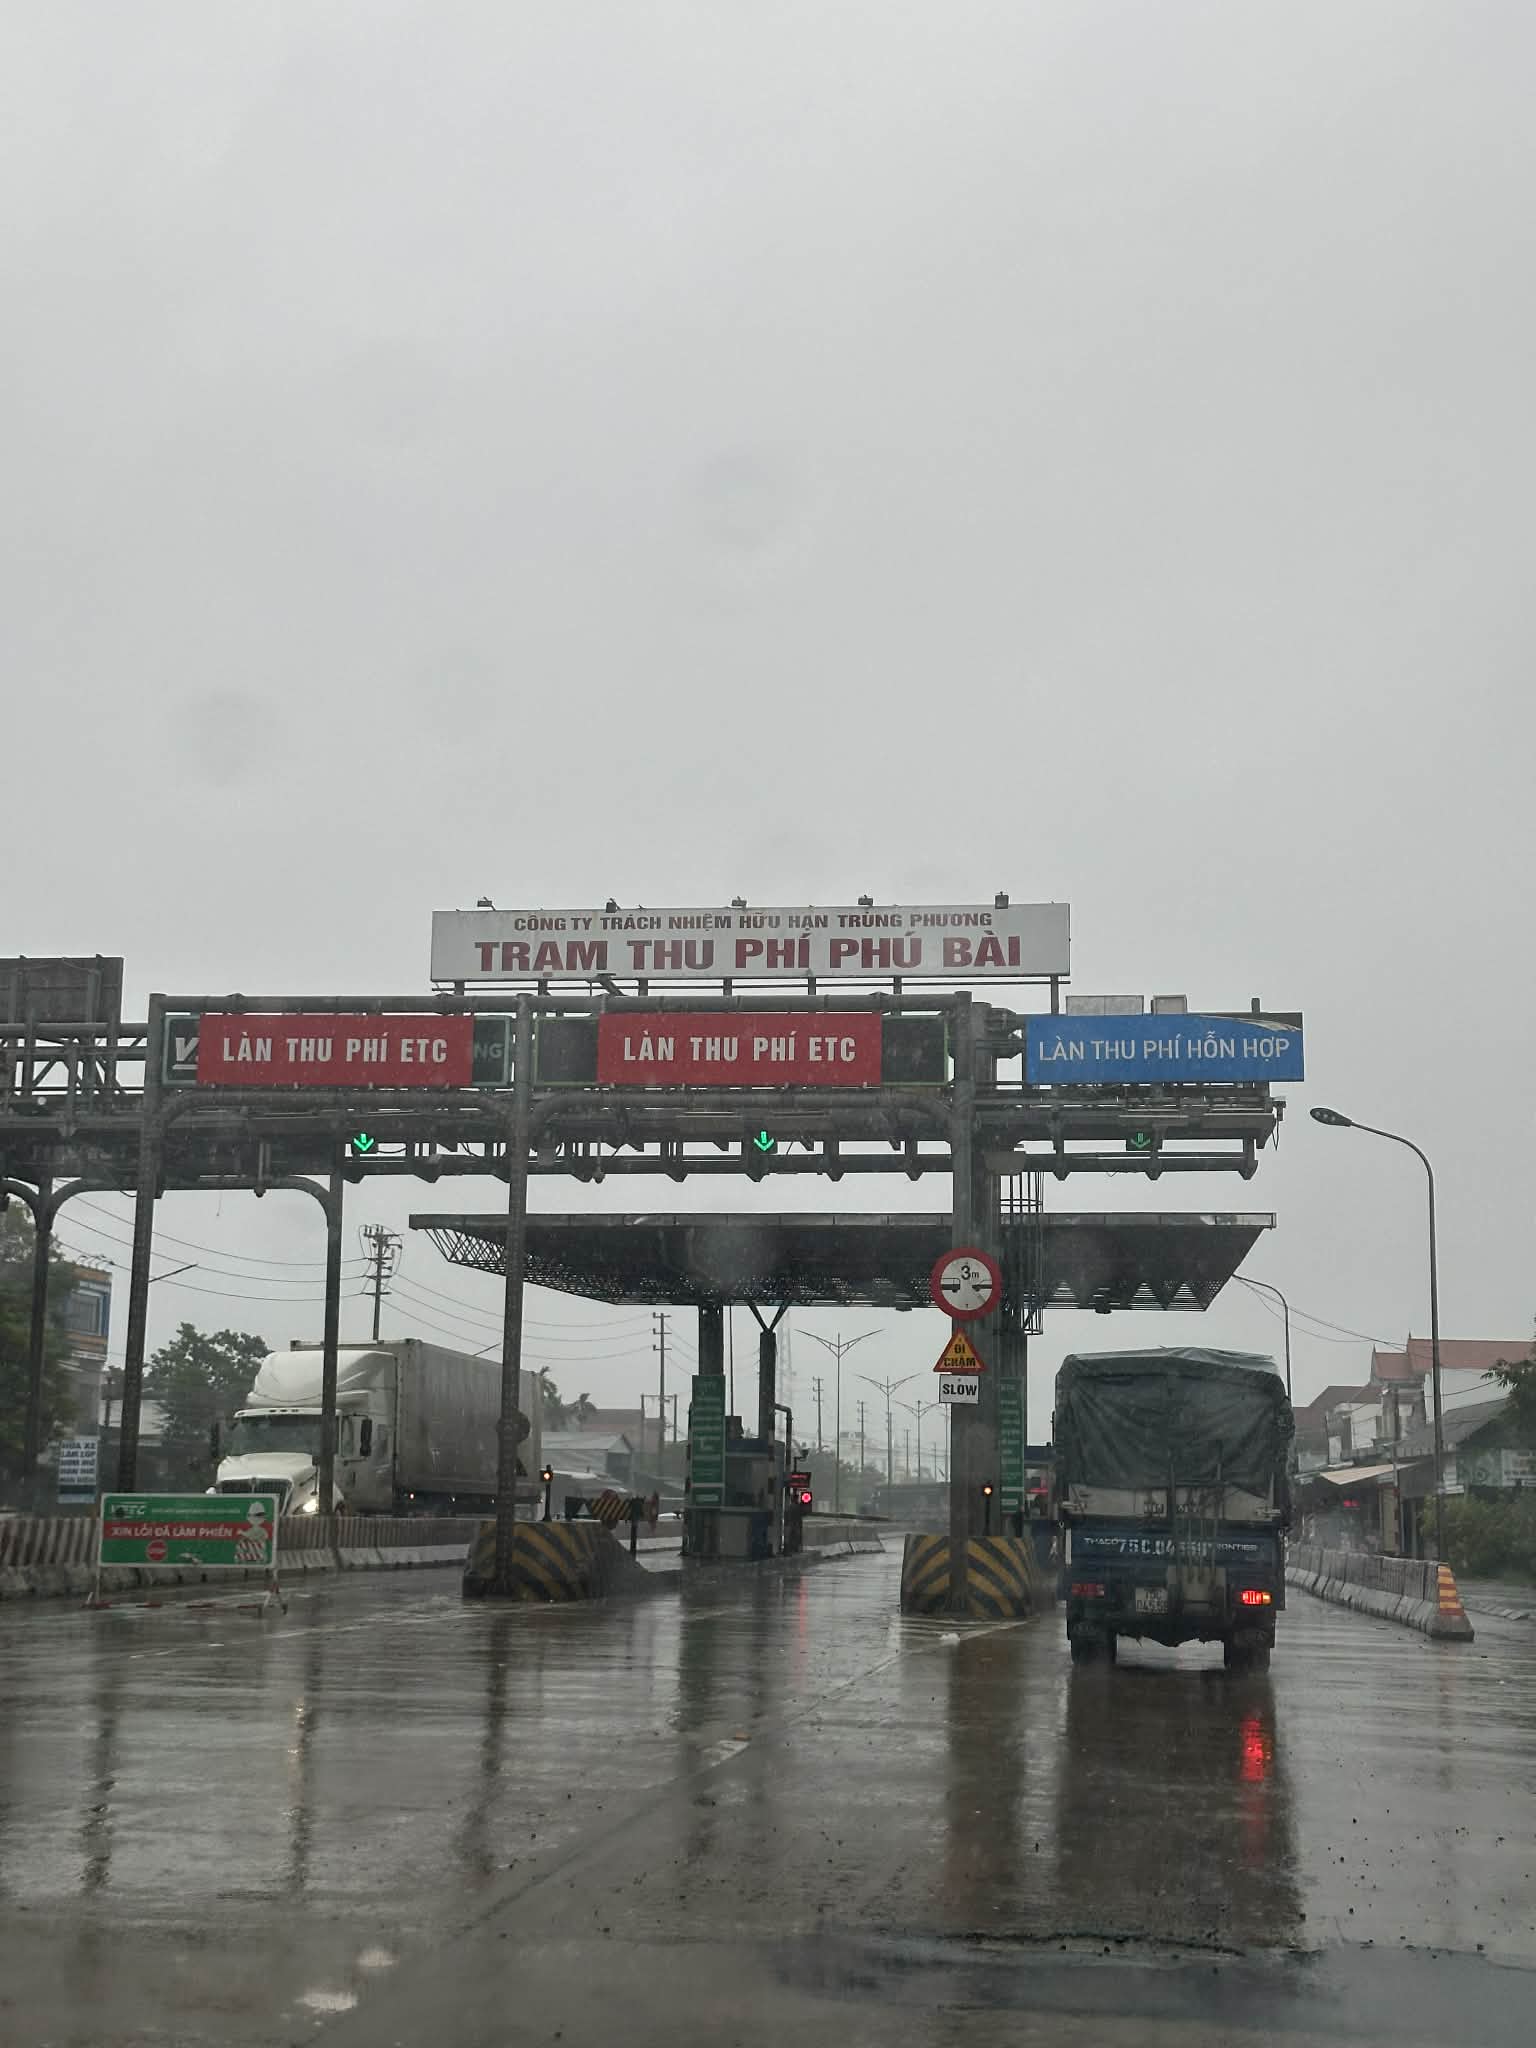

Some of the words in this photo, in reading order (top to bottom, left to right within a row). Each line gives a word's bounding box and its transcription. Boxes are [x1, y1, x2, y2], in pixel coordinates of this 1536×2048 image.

[514, 913, 566, 931] CÔNG
[572, 917, 593, 931] TY
[600, 913, 662, 930] TRÁCH
[668, 913, 732, 932] NHIỆM
[788, 914, 828, 931] HẠN
[910, 911, 993, 928] PHƯƠNG
[474, 939, 609, 977] TRẠM
[626, 938, 715, 970] THU
[735, 932, 810, 970] PHÍ
[829, 931, 922, 969] PHÚ
[943, 930, 1021, 968] BÀI
[223, 1032, 273, 1062] LÀN
[287, 1037, 333, 1063] THU
[346, 1032, 388, 1063] PHÍ
[400, 1037, 448, 1063] ETC
[624, 1030, 675, 1061] LÀN
[690, 1036, 738, 1062] THU
[753, 1030, 796, 1062] PHÍ
[808, 1036, 856, 1062] ETC
[1039, 1035, 1085, 1061] LÀN
[1091, 1039, 1136, 1061] THU
[1143, 1034, 1181, 1060] PHÍ
[1187, 1031, 1235, 1059] HỖN
[1243, 1036, 1290, 1062] HỢP
[942, 1383, 977, 1396] SLOW
